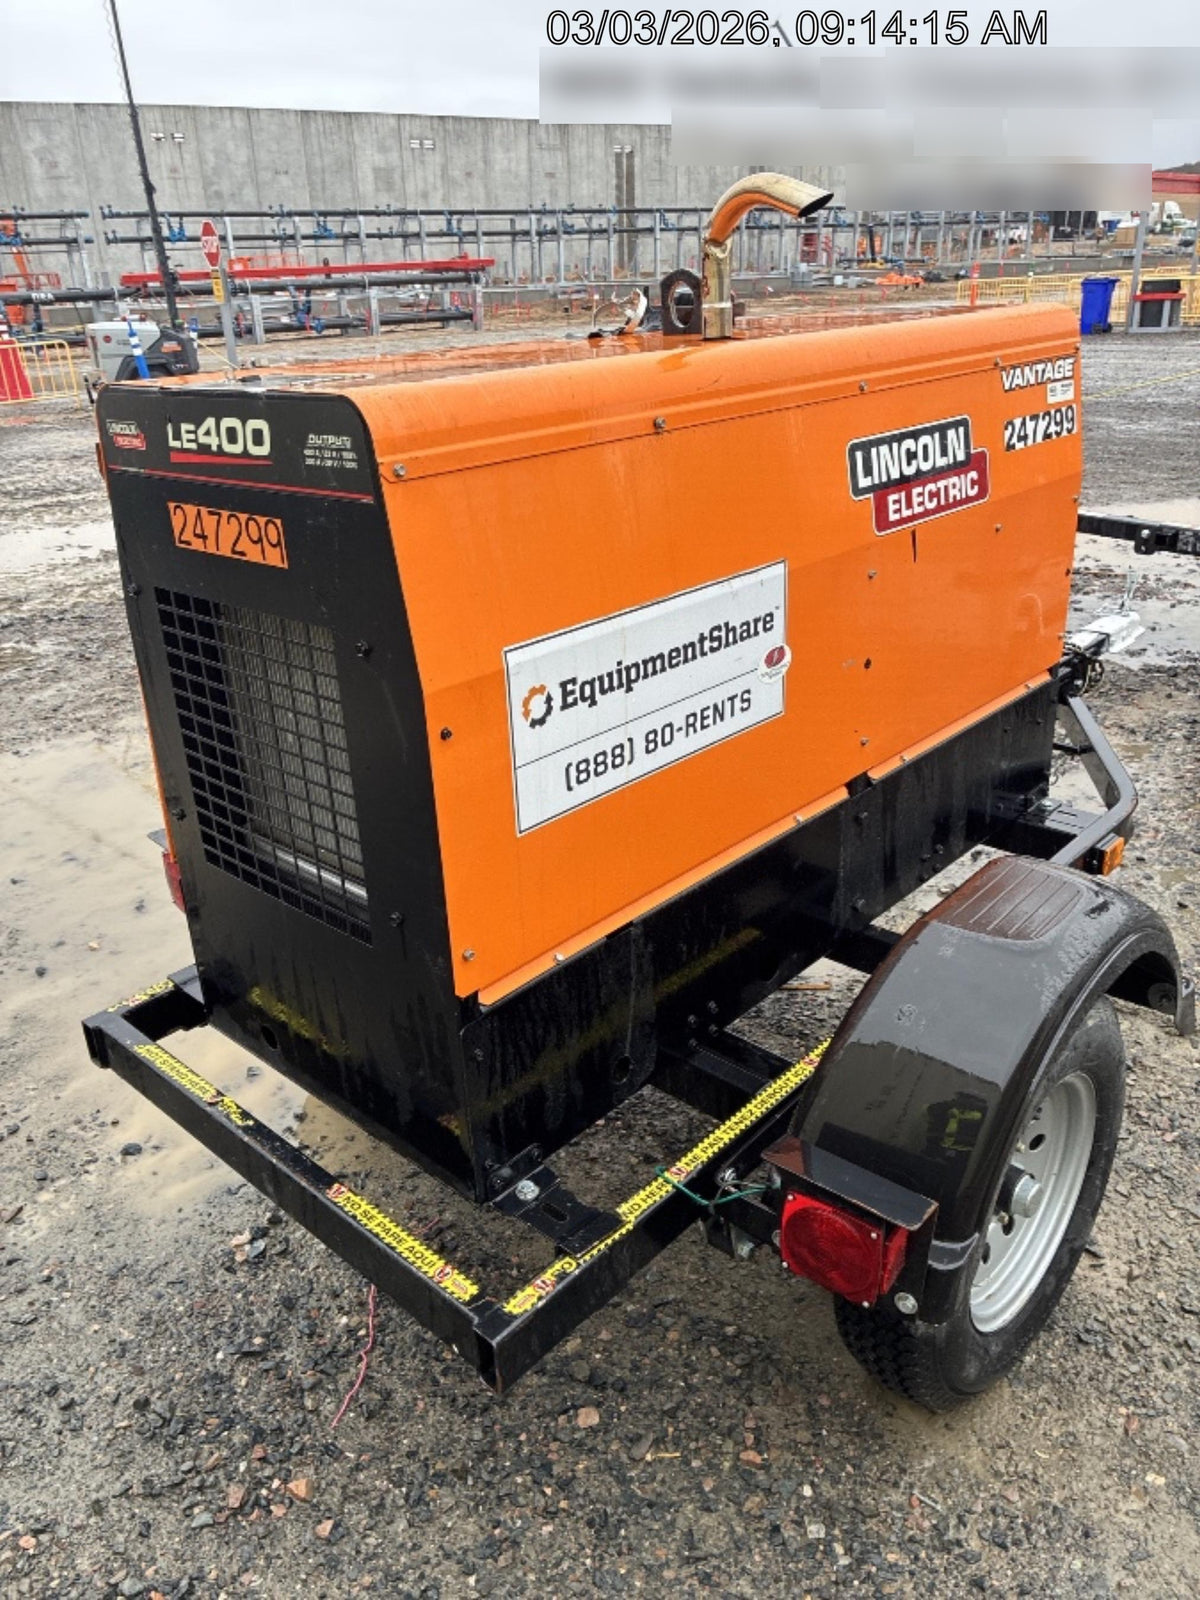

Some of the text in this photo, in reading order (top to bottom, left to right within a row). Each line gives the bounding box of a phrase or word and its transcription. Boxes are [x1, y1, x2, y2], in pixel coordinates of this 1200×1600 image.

[1000, 357, 1076, 392] VANTAGE
[167, 417, 271, 456] LE400
[1004, 404, 1076, 451] 247299
[855, 426, 966, 489] LINCOLN
[888, 471, 979, 522] ELECTRIC
[172, 503, 286, 566] 247299
[559, 611, 775, 712] EquipmentShare
[565, 689, 752, 792] (888) 80-RENTS
[342, 1195, 362, 1211] NO
[359, 1209, 376, 1224] SE
[376, 1222, 408, 1247] PARE
